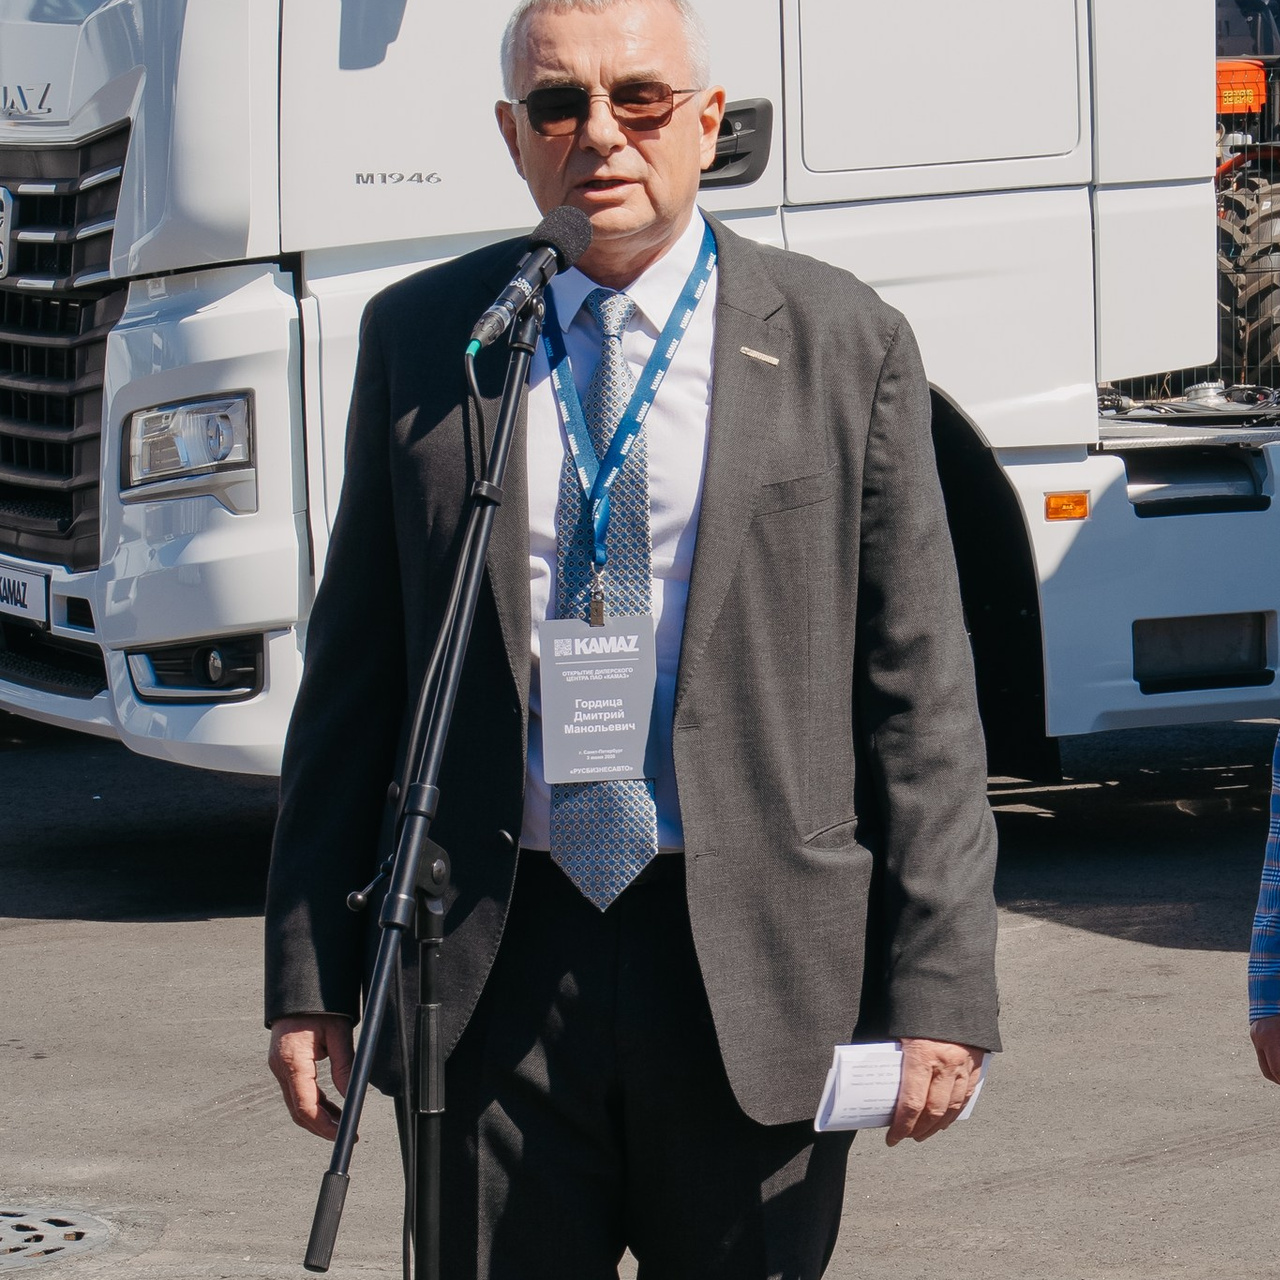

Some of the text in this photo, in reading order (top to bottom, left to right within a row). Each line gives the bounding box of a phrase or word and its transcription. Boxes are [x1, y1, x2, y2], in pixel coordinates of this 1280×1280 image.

[355, 172, 442, 184] M1946
[665, 338, 680, 360] KAMAZ
[551, 368, 562, 391] KAMAZ
[650, 369, 665, 391] KAMAZ
[559, 400, 571, 423] KAMAZ
[635, 401, 650, 423] KAMAZ
[568, 433, 580, 456] KAMAZ
[619, 433, 636, 456] KAMAZ
[578, 467, 591, 489] KAMAZ
[603, 466, 620, 487] KAMAZ
[574, 635, 640, 655] KAMAZ
[575, 698, 623, 710] Гордица
[573, 709, 625, 723] Дмитрий
[564, 723, 636, 734] Манольевич
